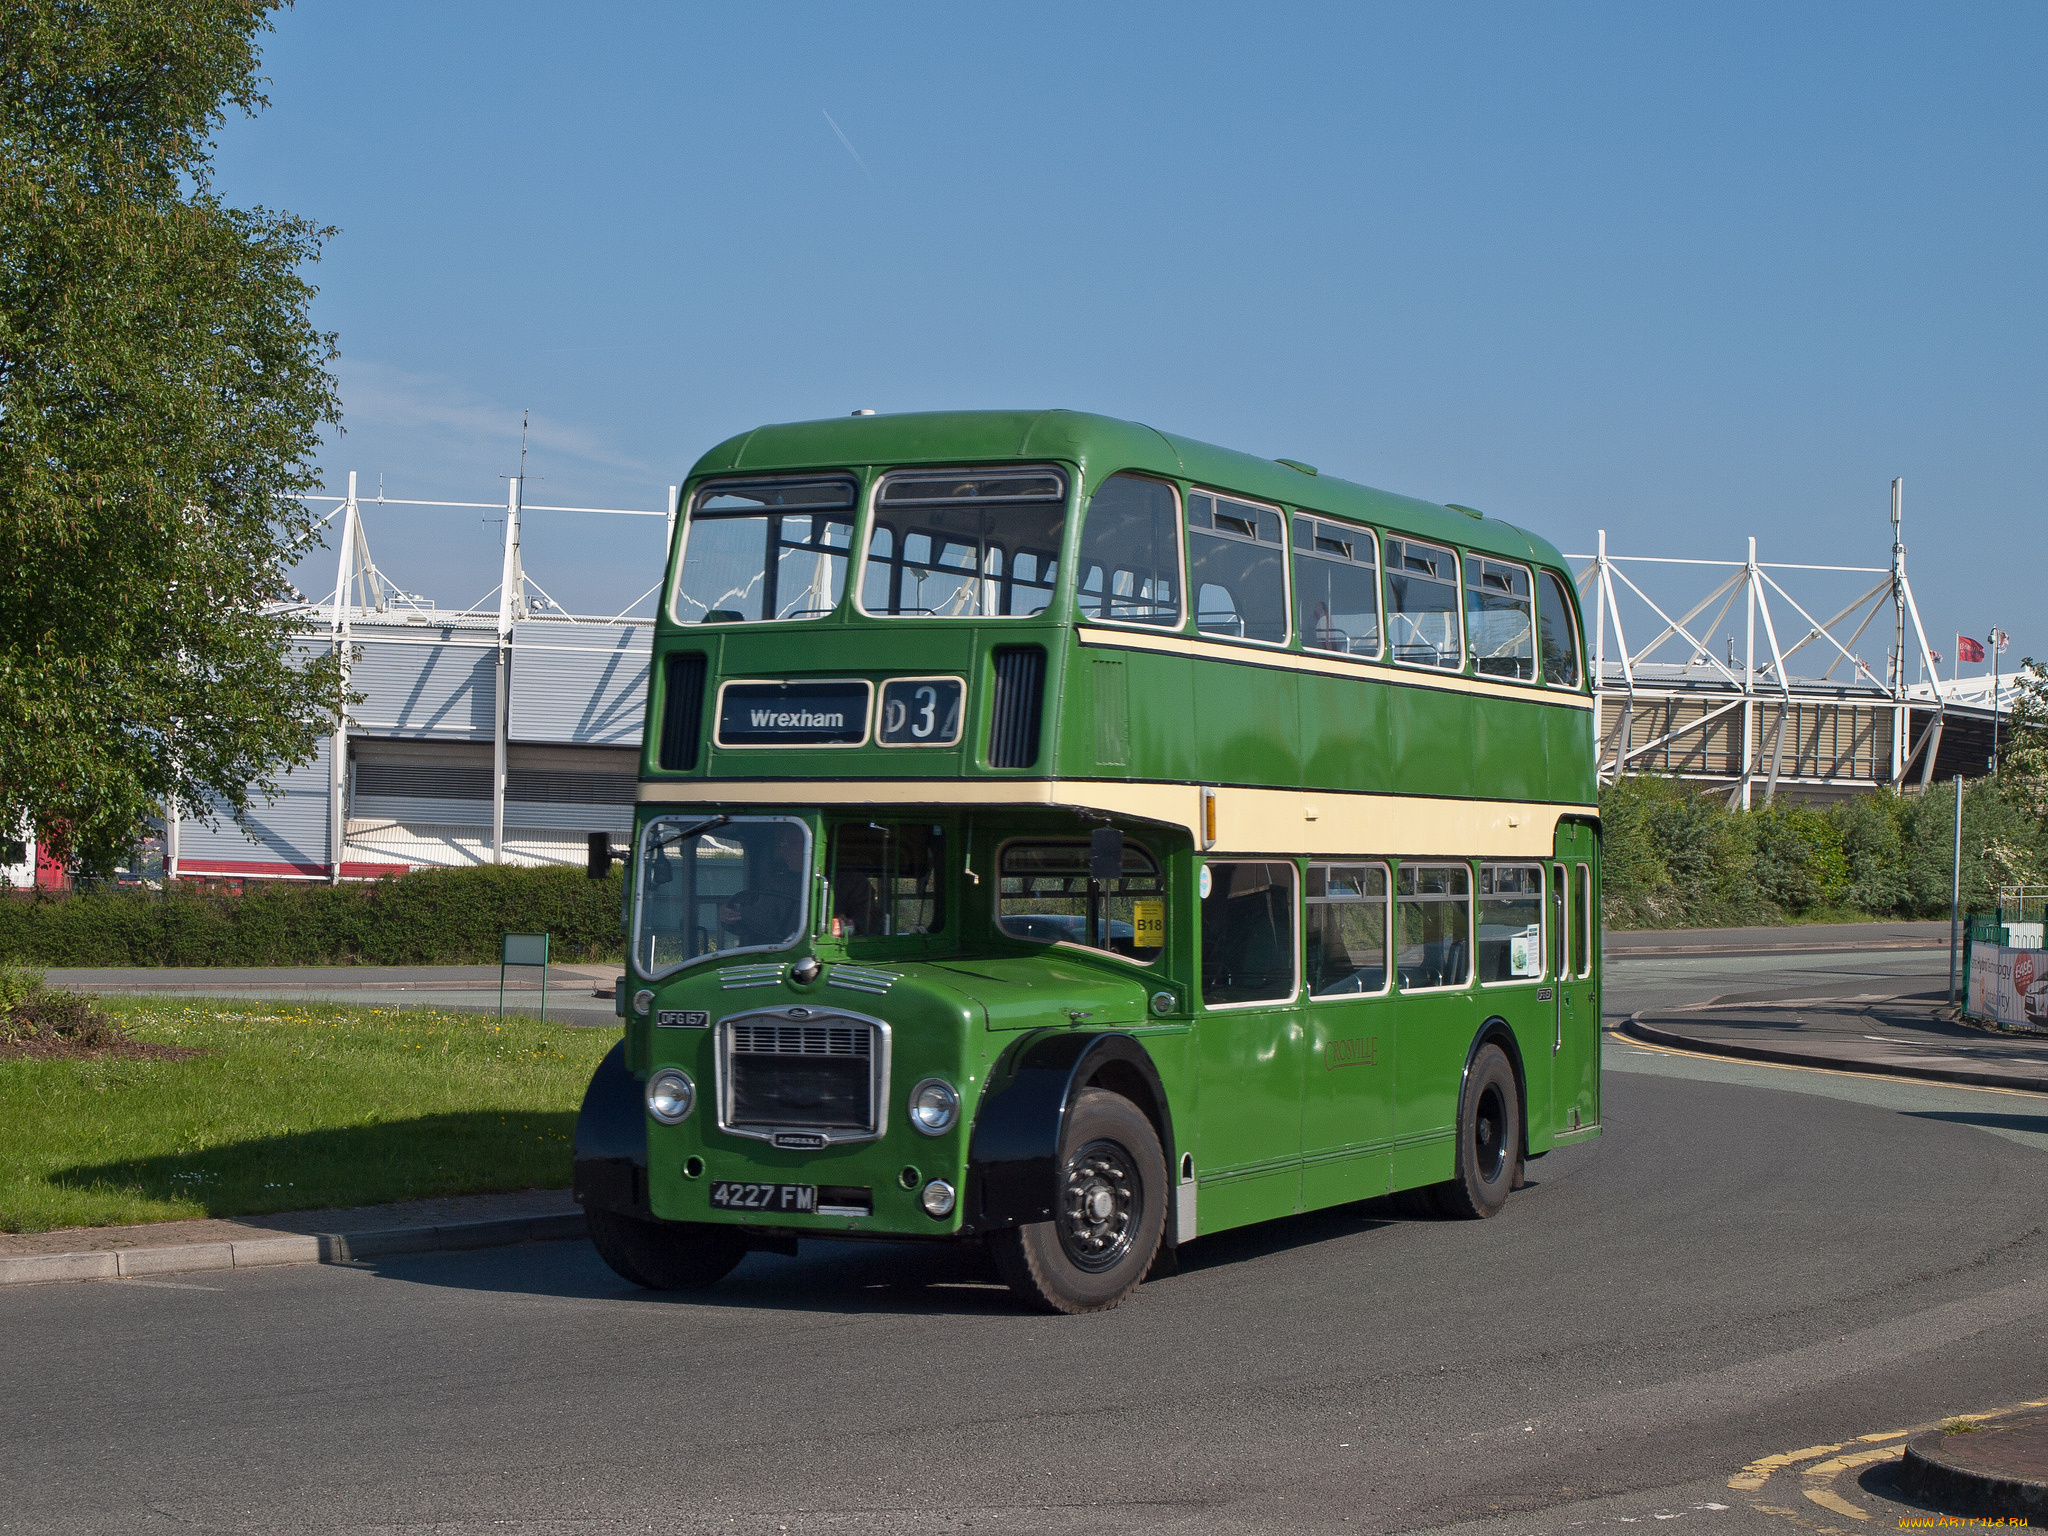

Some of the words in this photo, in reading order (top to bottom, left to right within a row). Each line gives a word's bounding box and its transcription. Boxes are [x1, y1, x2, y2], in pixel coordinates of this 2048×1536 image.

[751, 709, 844, 728] Wrexham
[911, 686, 937, 737] 3
[1137, 919, 1163, 931] B18
[1324, 1036, 1379, 1072] CROSVILLE
[714, 1183, 775, 1207] 4227
[781, 1186, 813, 1210] FM
